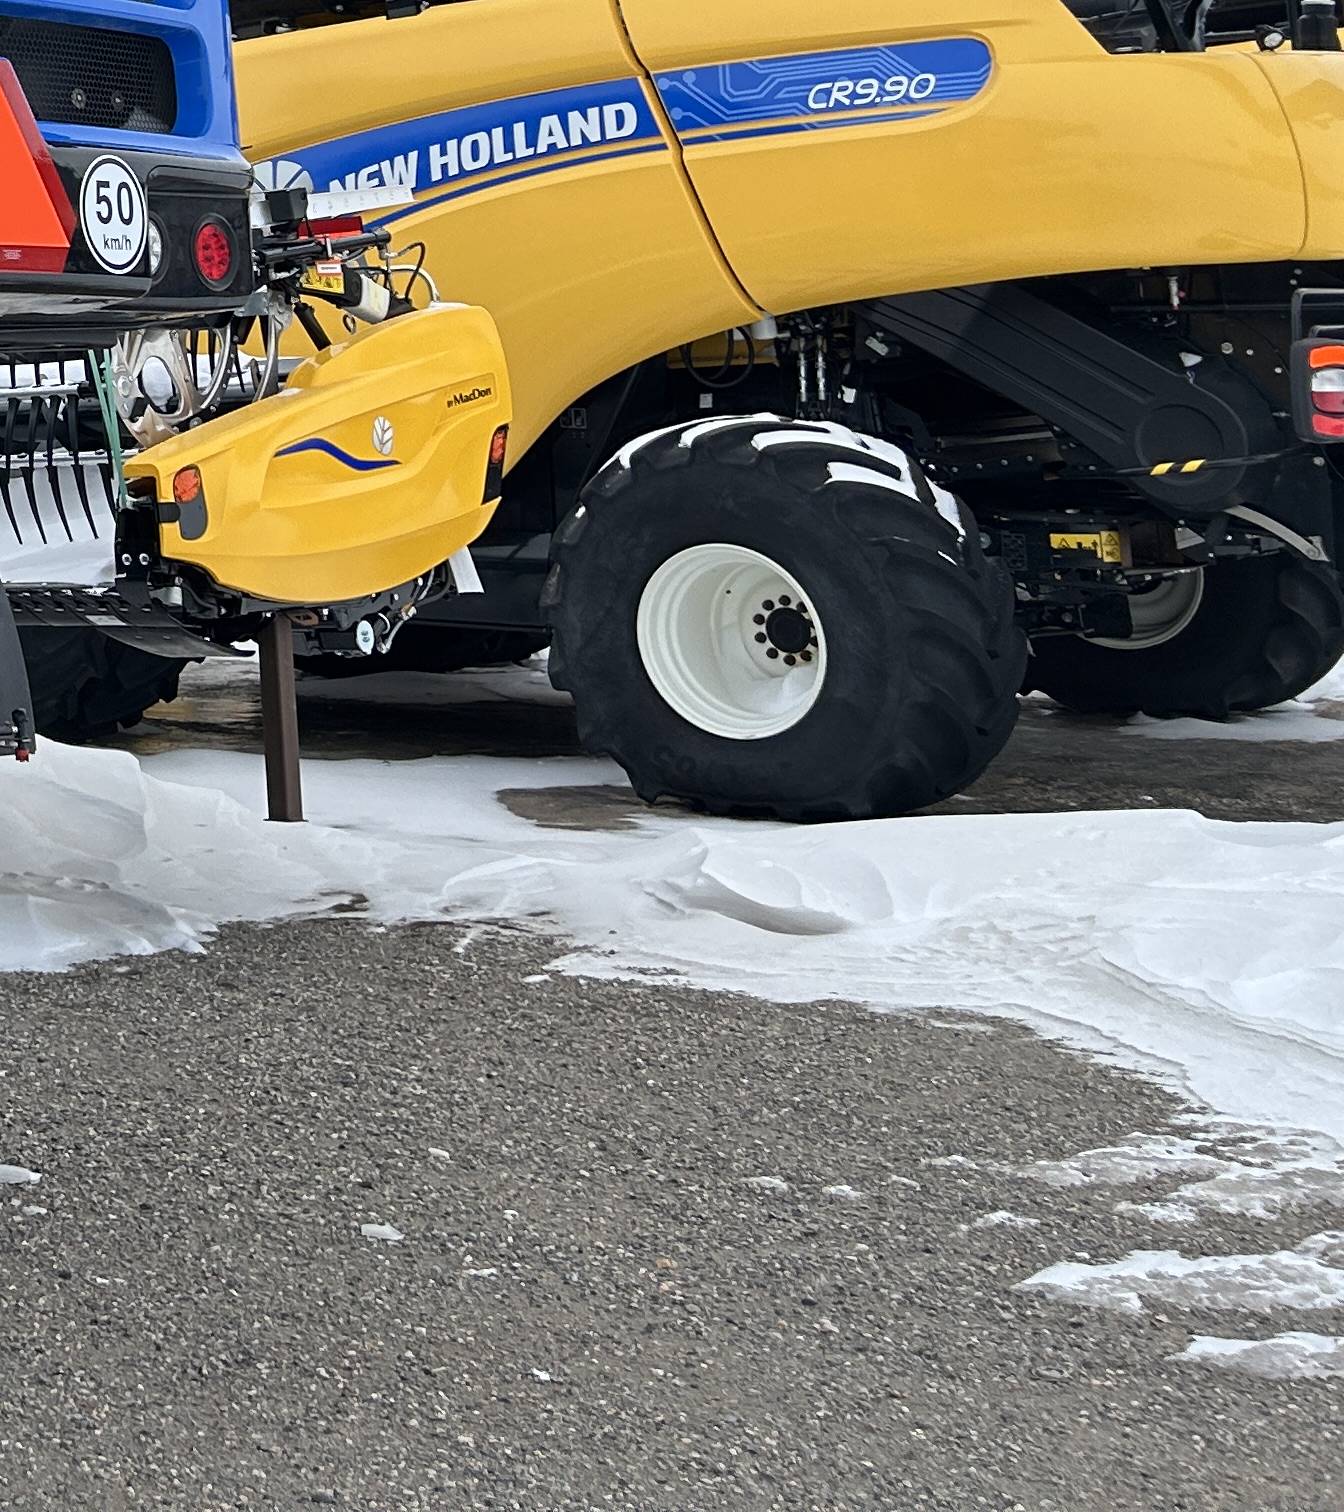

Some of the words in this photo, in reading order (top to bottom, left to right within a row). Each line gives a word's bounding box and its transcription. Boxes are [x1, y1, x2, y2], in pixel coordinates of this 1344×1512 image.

[808, 73, 936, 109] CR9.90
[429, 101, 638, 182] HOLLAND
[95, 180, 134, 226] 50
[102, 233, 132, 251] km/h
